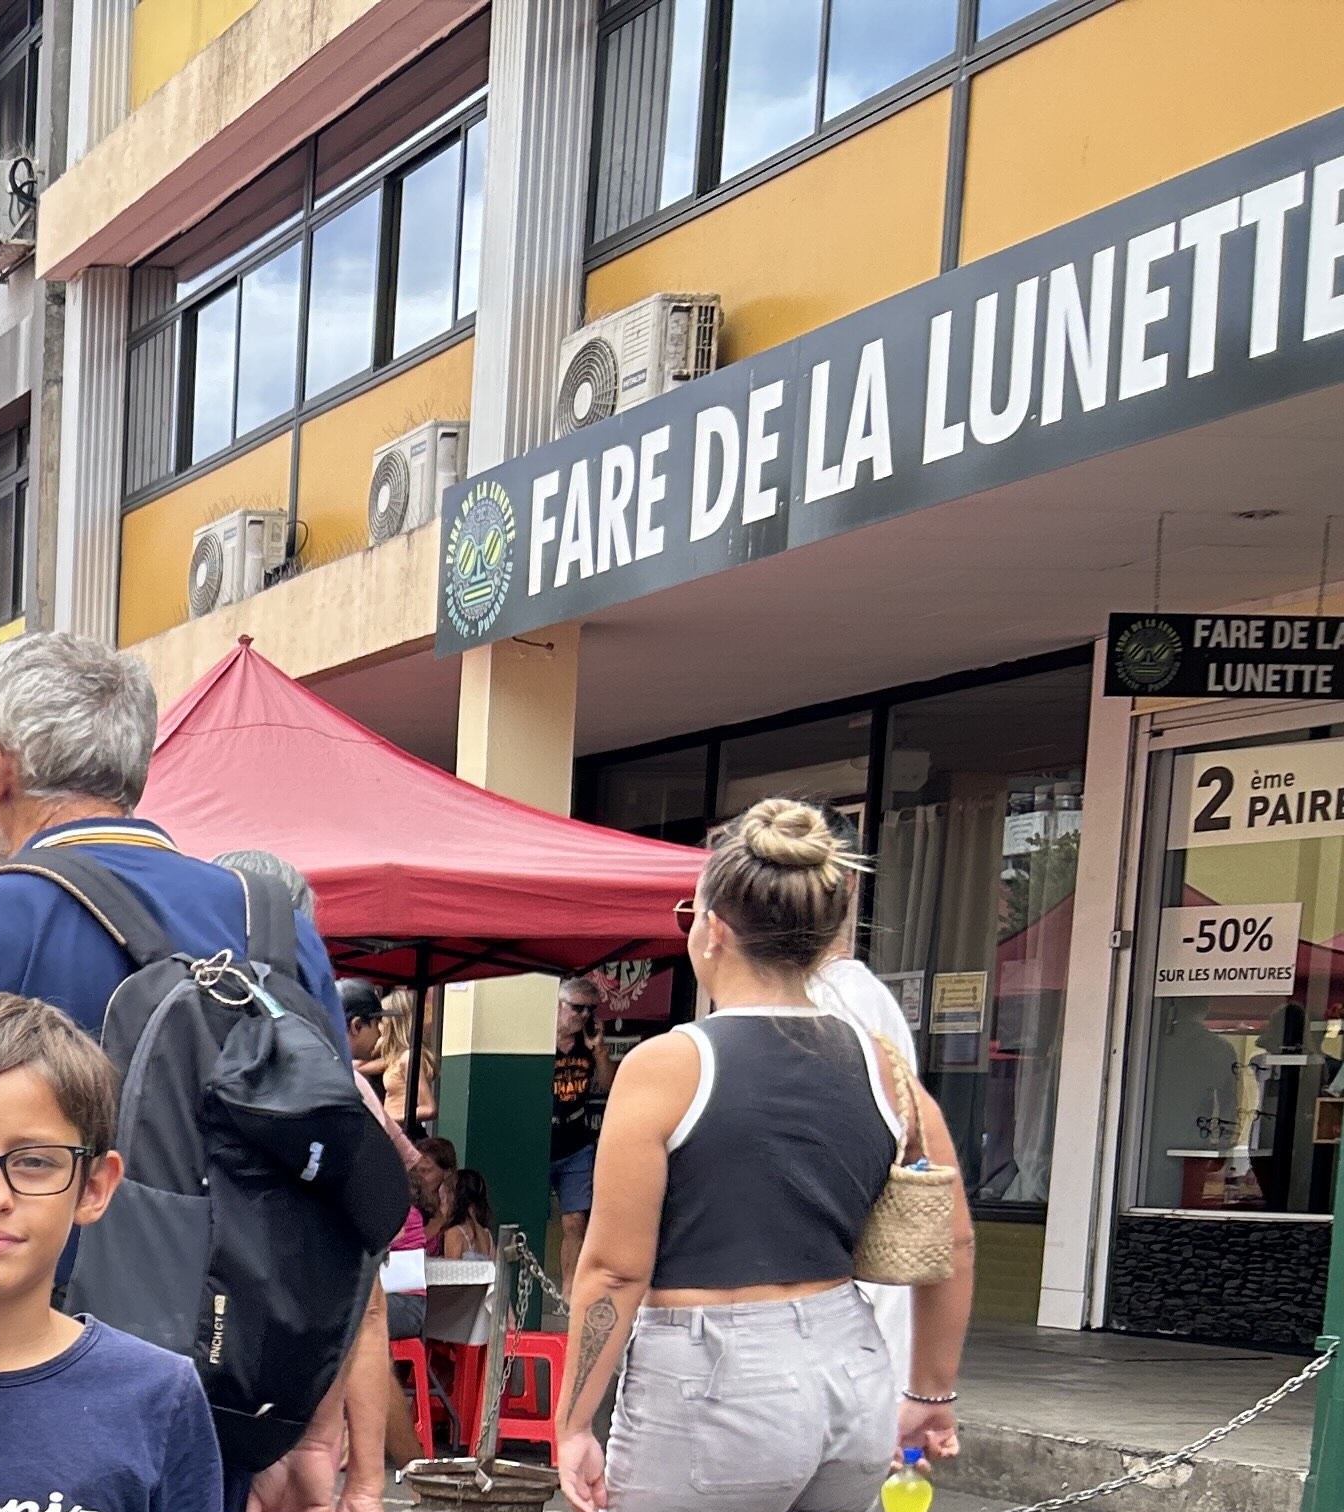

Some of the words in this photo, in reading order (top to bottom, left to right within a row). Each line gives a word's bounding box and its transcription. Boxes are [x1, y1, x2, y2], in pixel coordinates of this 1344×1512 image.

[527, 424, 671, 598] FARE
[689, 380, 784, 543] DE
[803, 338, 893, 505] LA
[1193, 619, 1265, 648] FARE
[1272, 620, 1310, 650] DE
[1207, 663, 1334, 693] LUNETTE
[1193, 765, 1235, 833] 2
[1251, 770, 1295, 790] ème
[1182, 917, 1273, 953] -50%
[1158, 969, 1185, 982] SUR
[1188, 968, 1210, 981] LES
